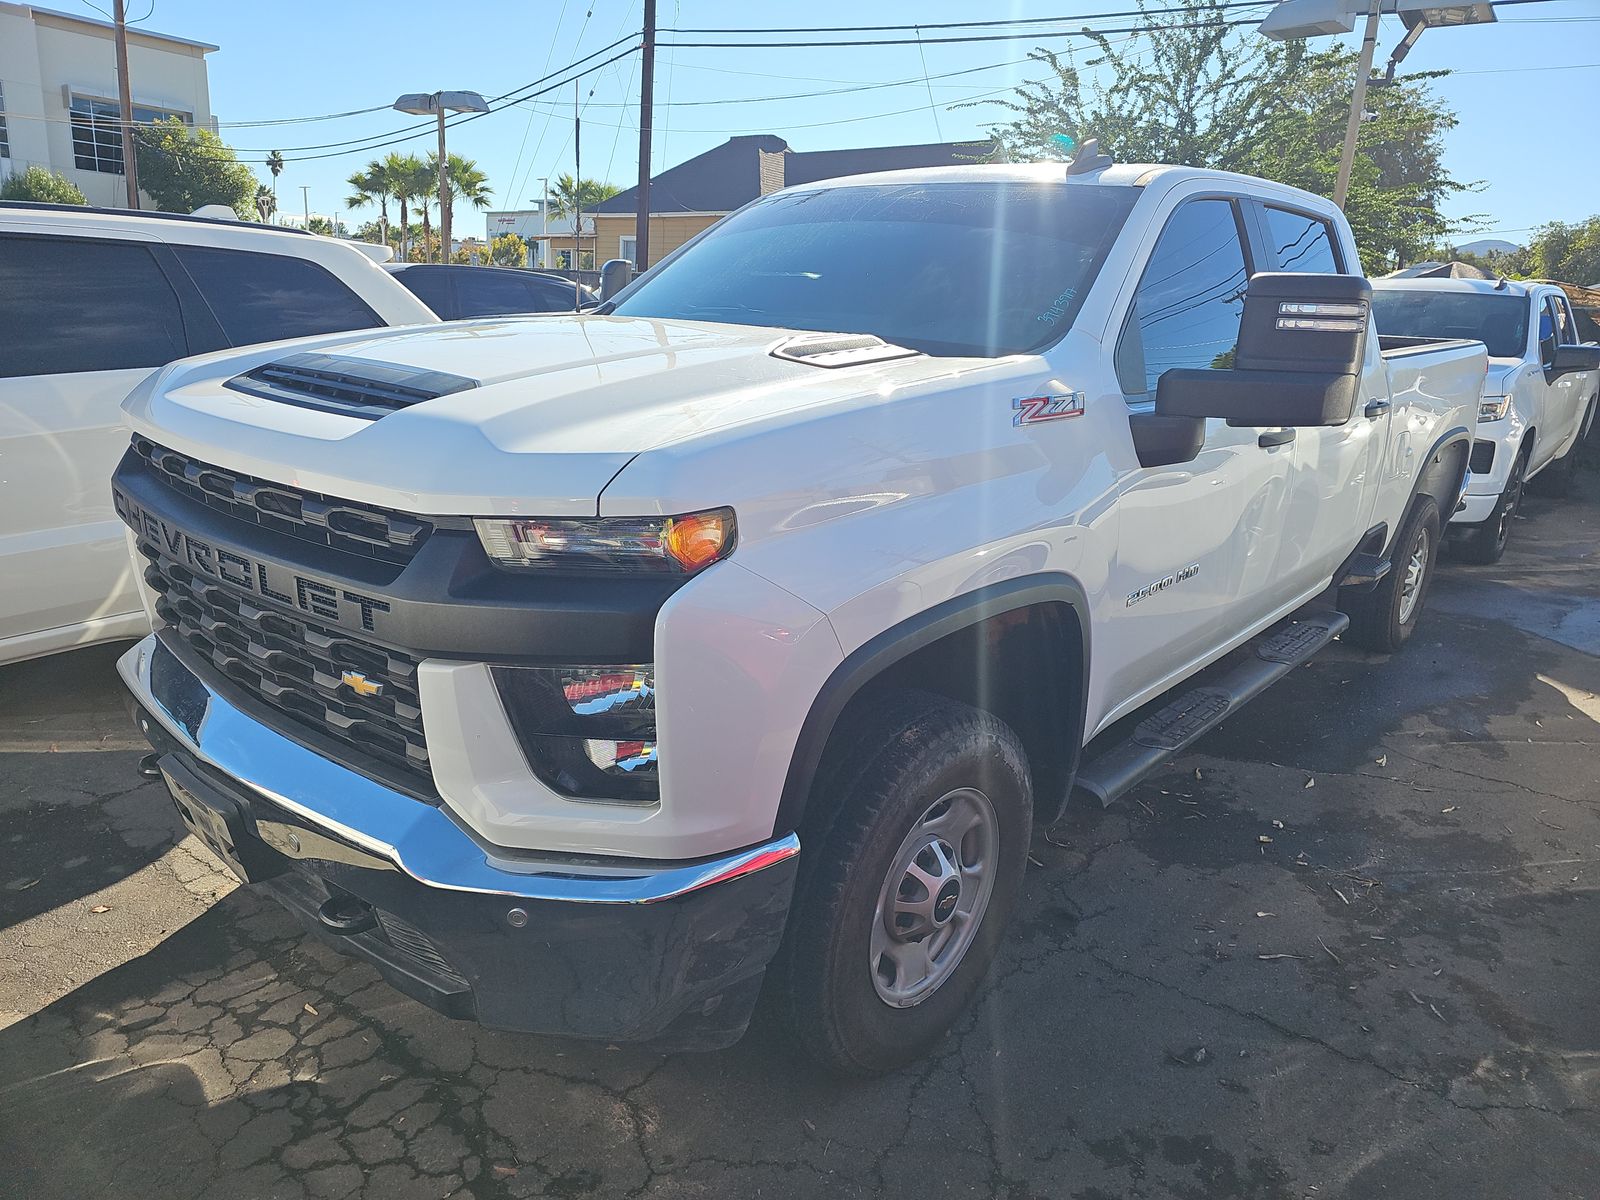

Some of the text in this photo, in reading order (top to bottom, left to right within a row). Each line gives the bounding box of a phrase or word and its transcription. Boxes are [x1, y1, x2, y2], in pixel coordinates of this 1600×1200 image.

[1012, 391, 1085, 427] Z71
[113, 487, 391, 633] CHEVROLET
[1126, 563, 1200, 608] 2500 HD
